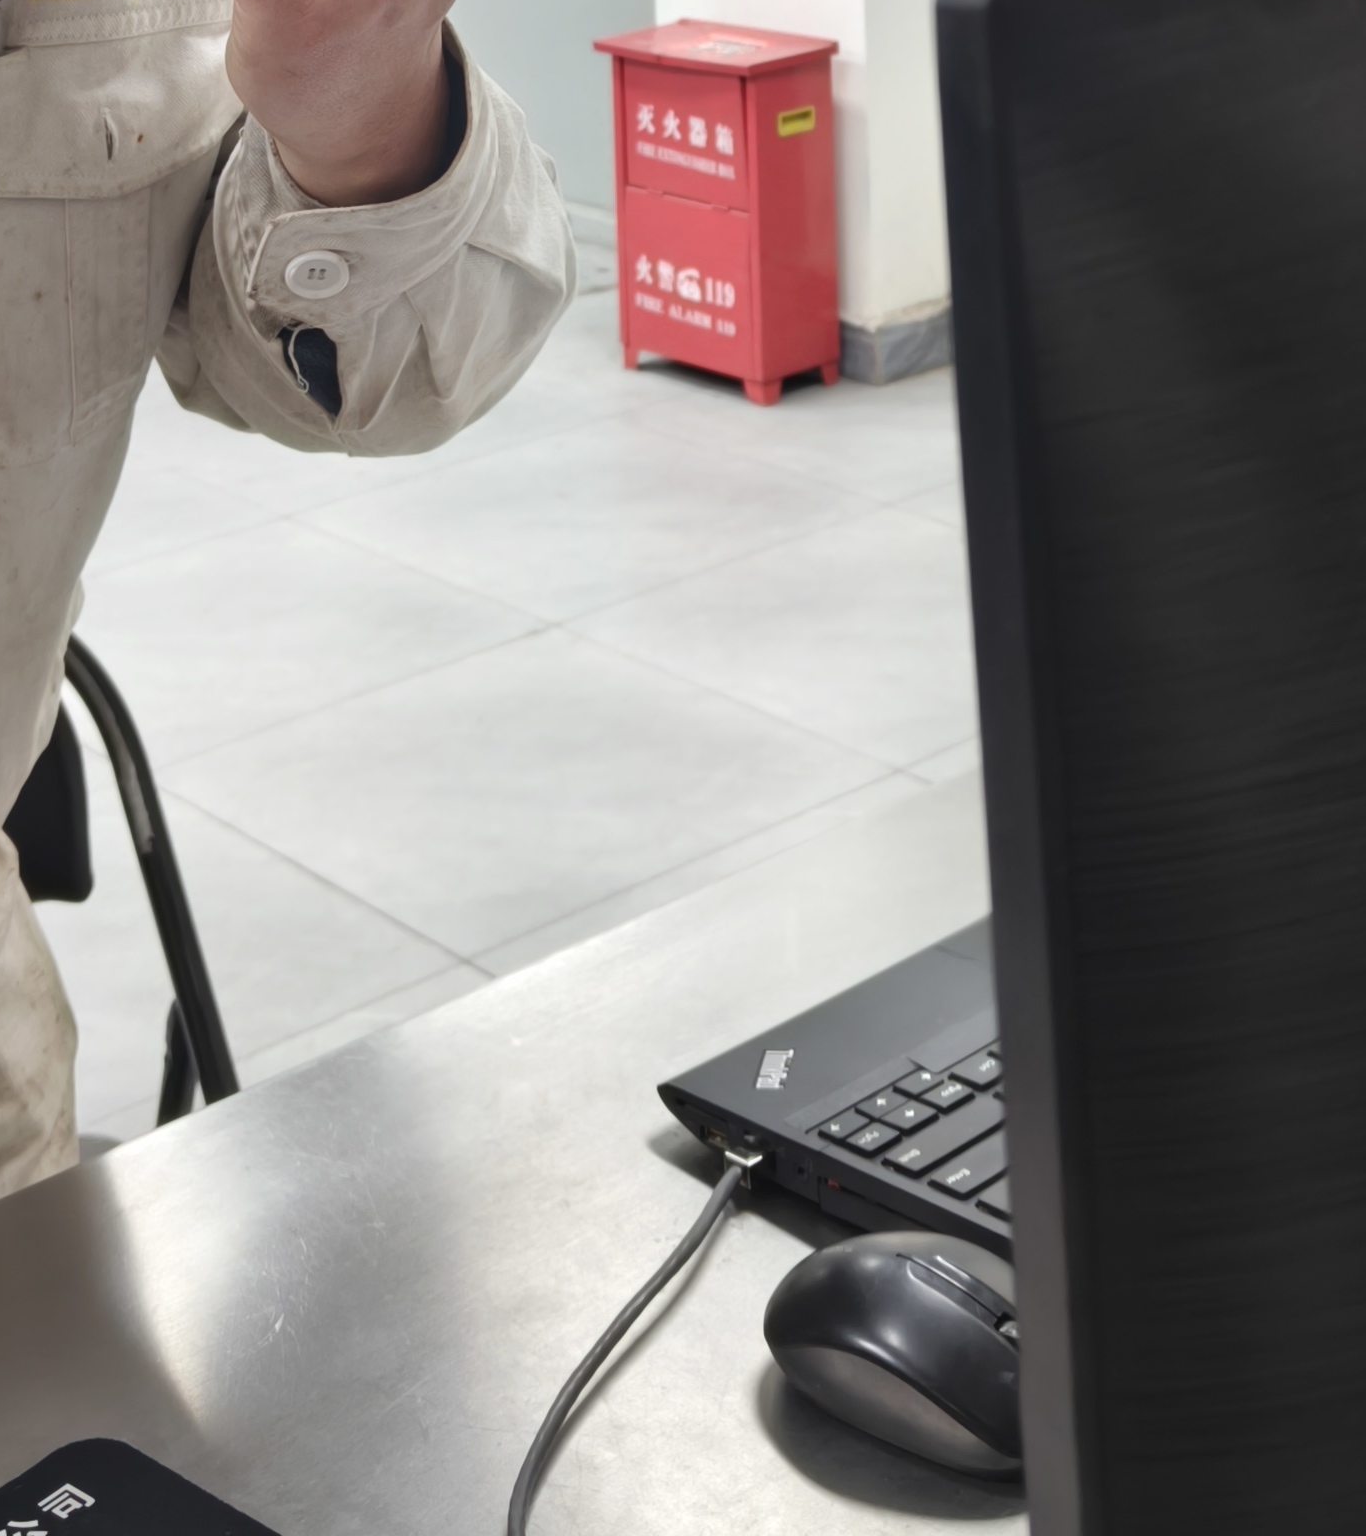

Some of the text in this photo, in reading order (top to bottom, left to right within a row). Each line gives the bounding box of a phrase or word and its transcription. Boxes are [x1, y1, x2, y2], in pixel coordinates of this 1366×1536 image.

[636, 103, 735, 156] 灭火器箱
[636, 254, 736, 309] 火警 119
[635, 291, 665, 315] FIRE
[668, 304, 713, 331] ALARM
